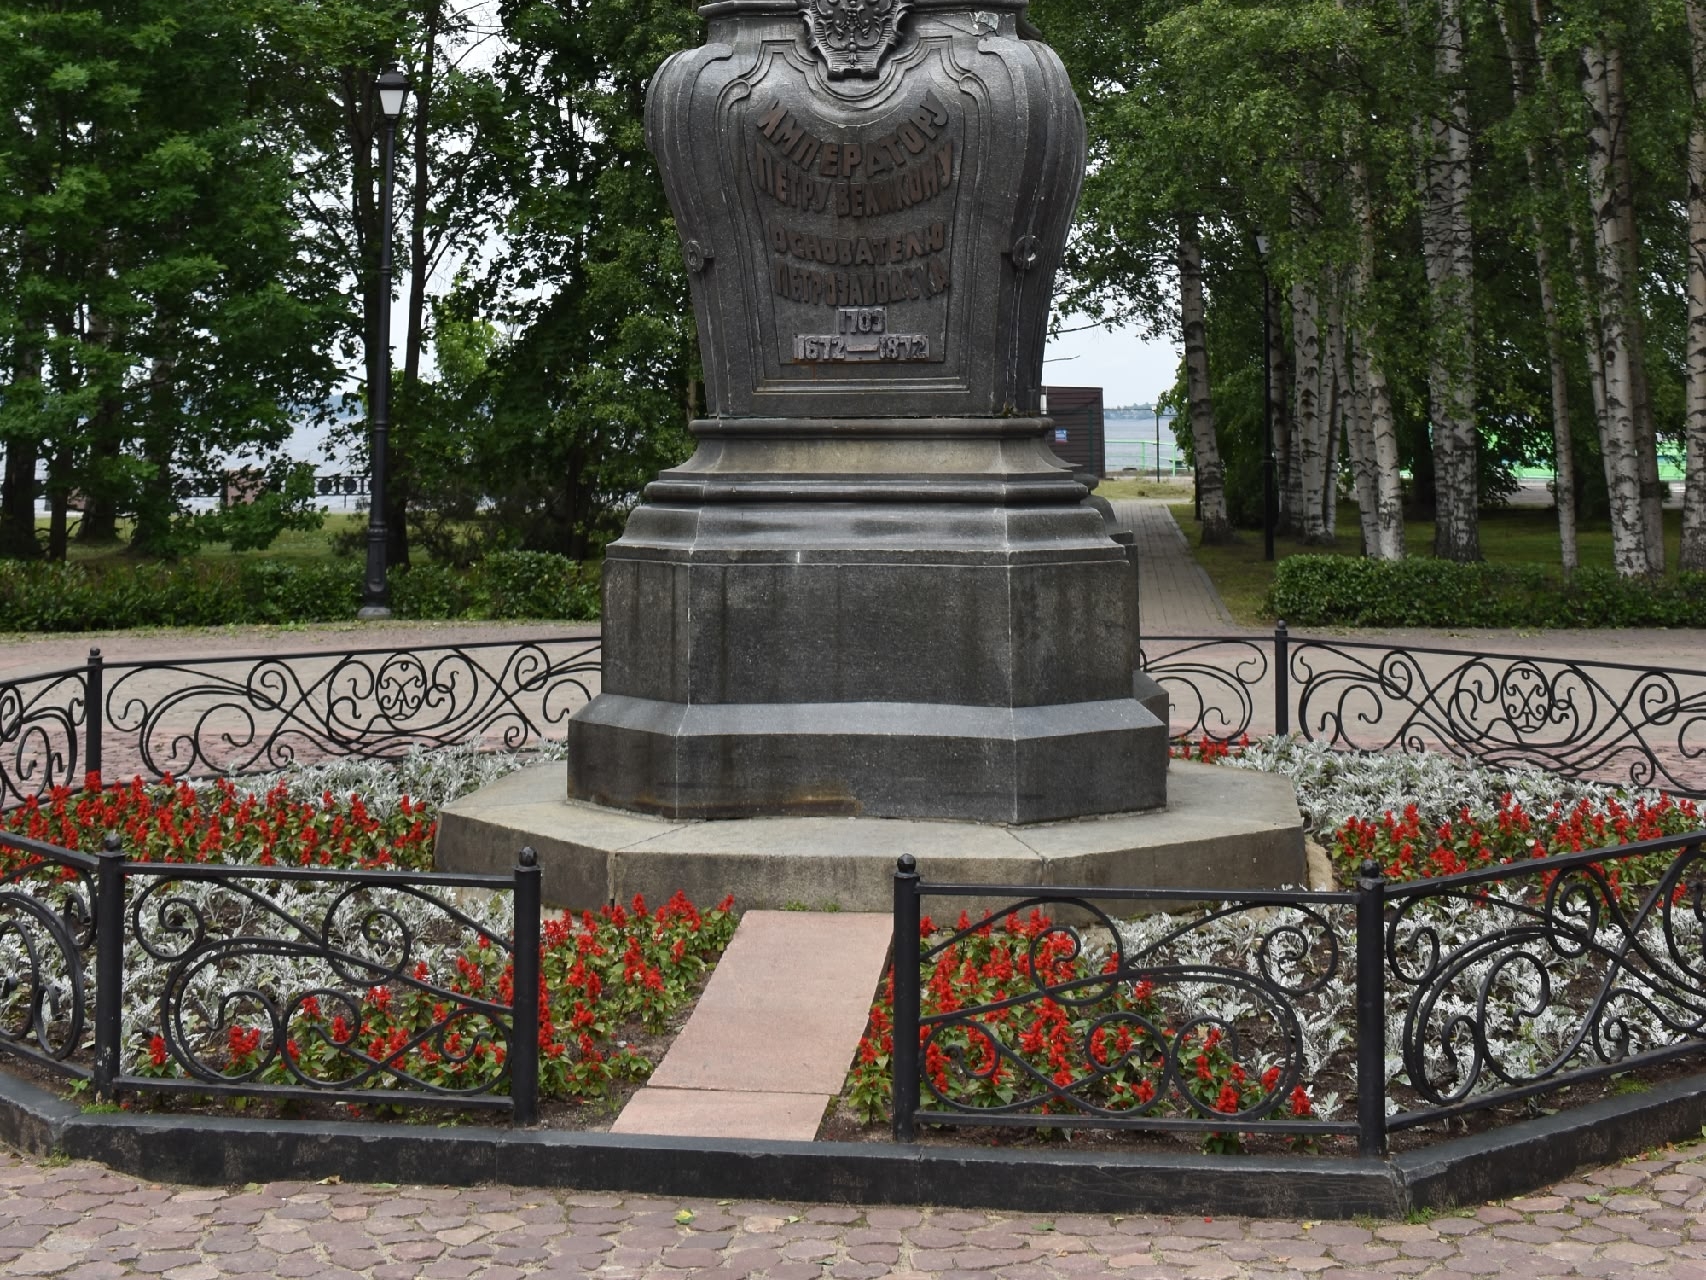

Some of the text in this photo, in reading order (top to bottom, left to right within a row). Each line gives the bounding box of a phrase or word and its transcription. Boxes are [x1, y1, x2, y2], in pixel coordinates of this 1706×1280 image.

[757, 89, 949, 177] ИМПЕРАТОРУ
[757, 137, 953, 217] ПЕТРУ ВЕЛИКОМУ
[769, 222, 945, 266] ОСНОВАТЕЛЮ
[774, 258, 950, 306] ПЕТРОЗАВОДСКА
[838, 308, 885, 334] 1703
